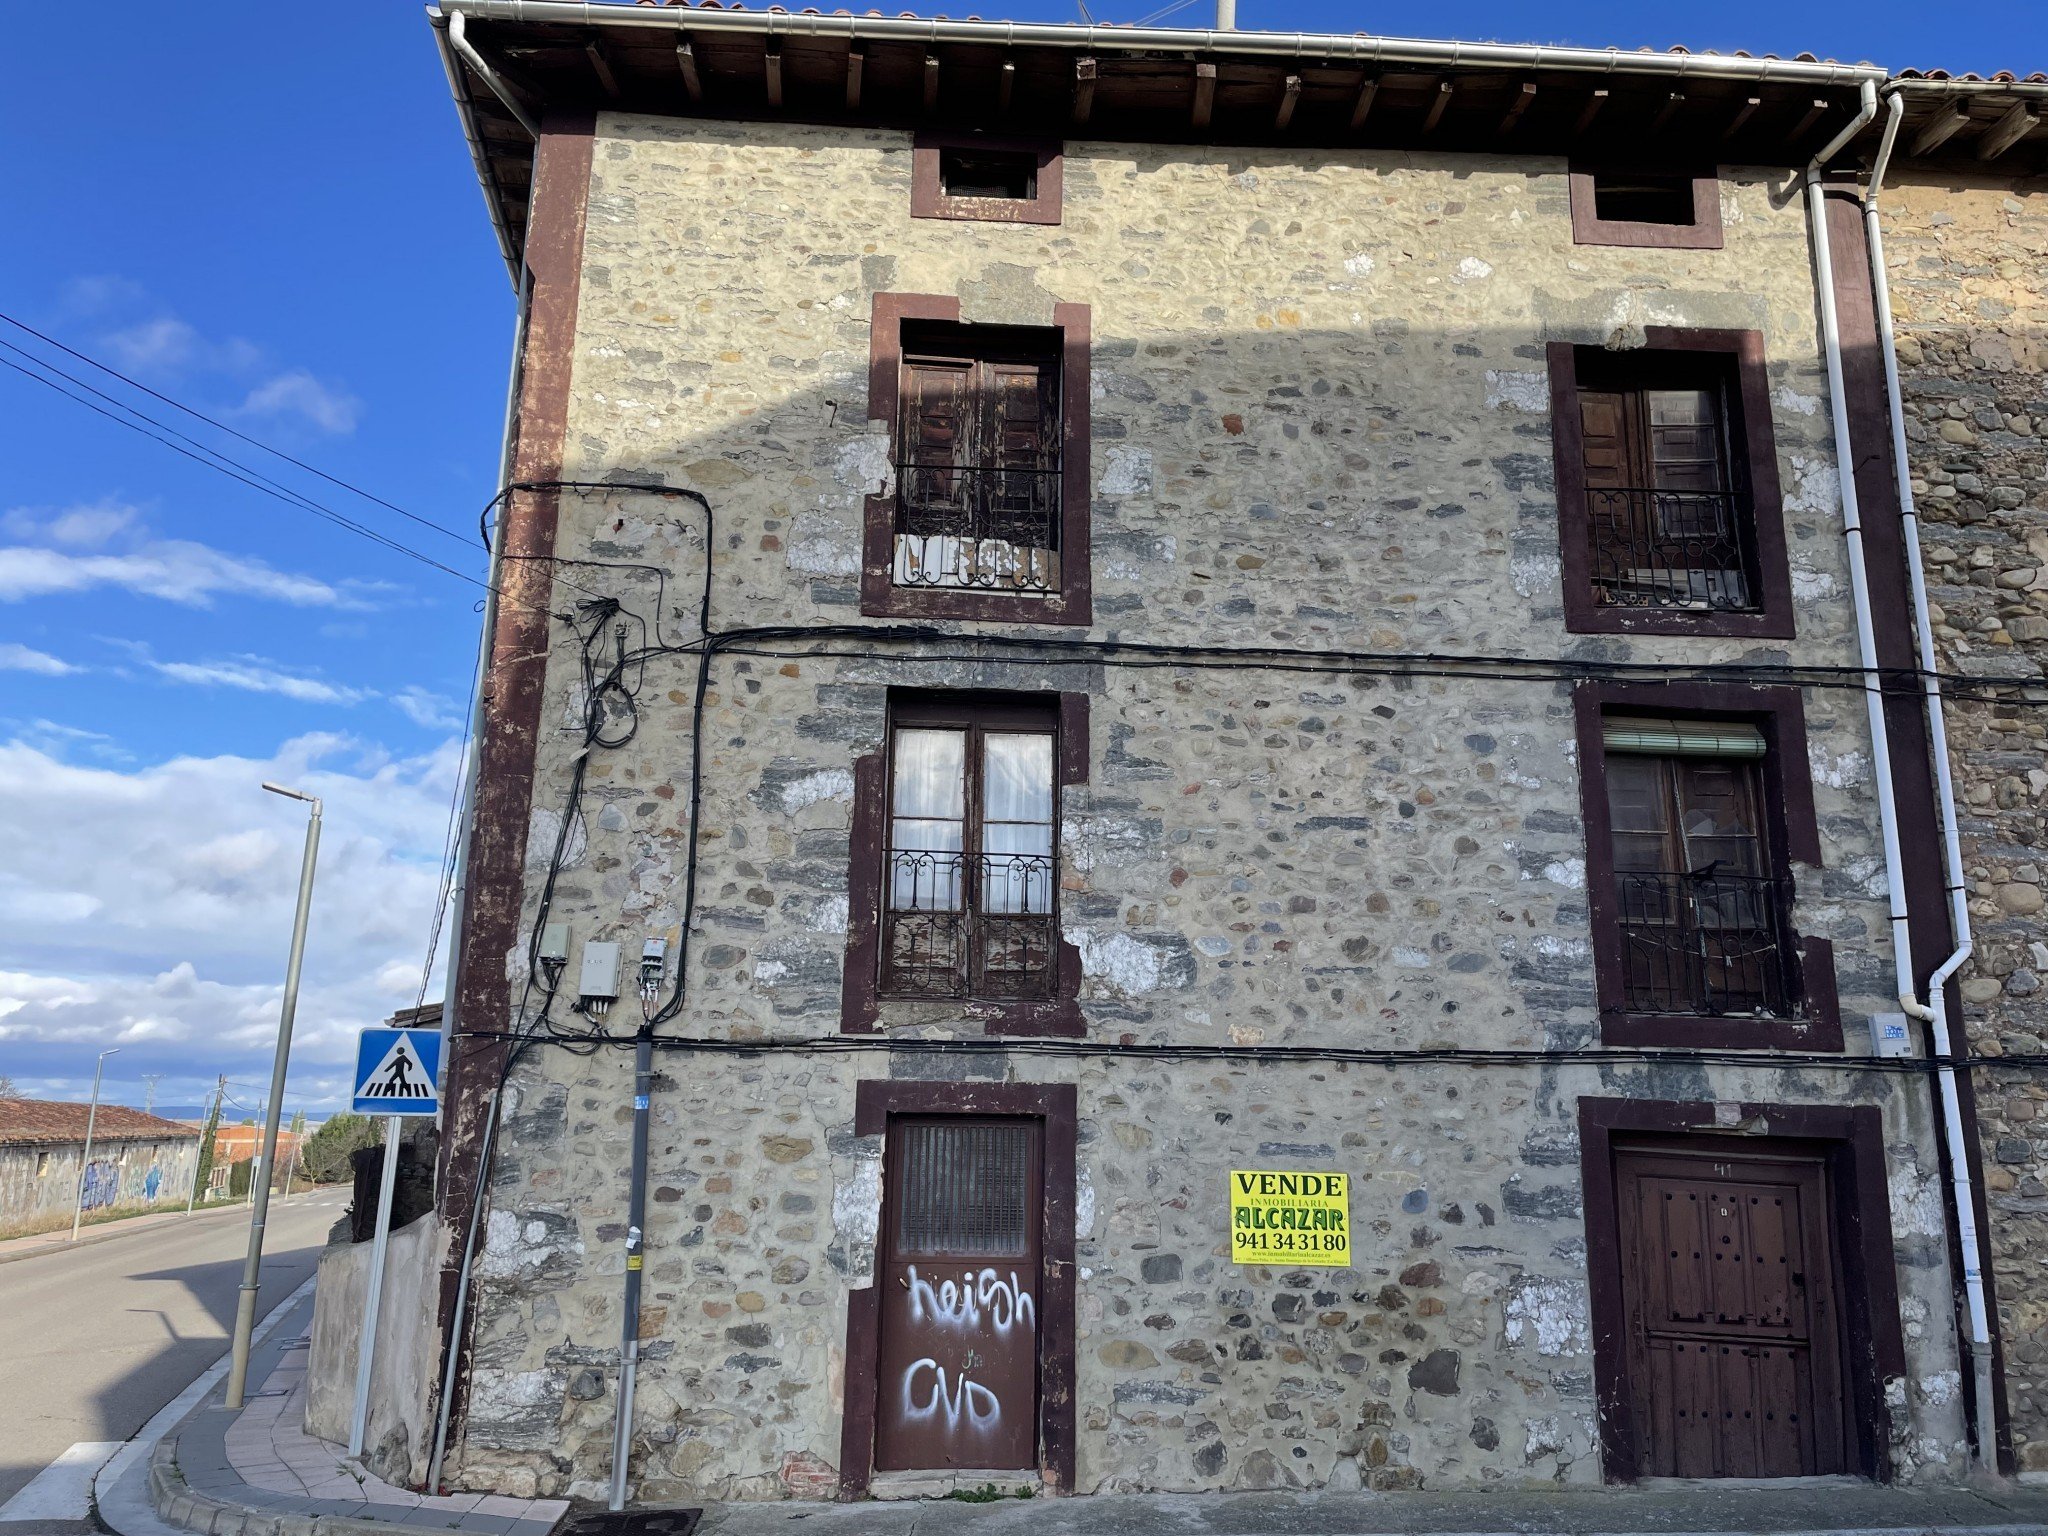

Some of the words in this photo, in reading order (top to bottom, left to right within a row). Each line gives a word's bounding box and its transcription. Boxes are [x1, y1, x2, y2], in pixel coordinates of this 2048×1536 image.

[1237, 1173, 1342, 1196] VENDE
[1250, 1198, 1329, 1207] INMOBILIARIA
[1235, 1206, 1345, 1231] ALCAZAR
